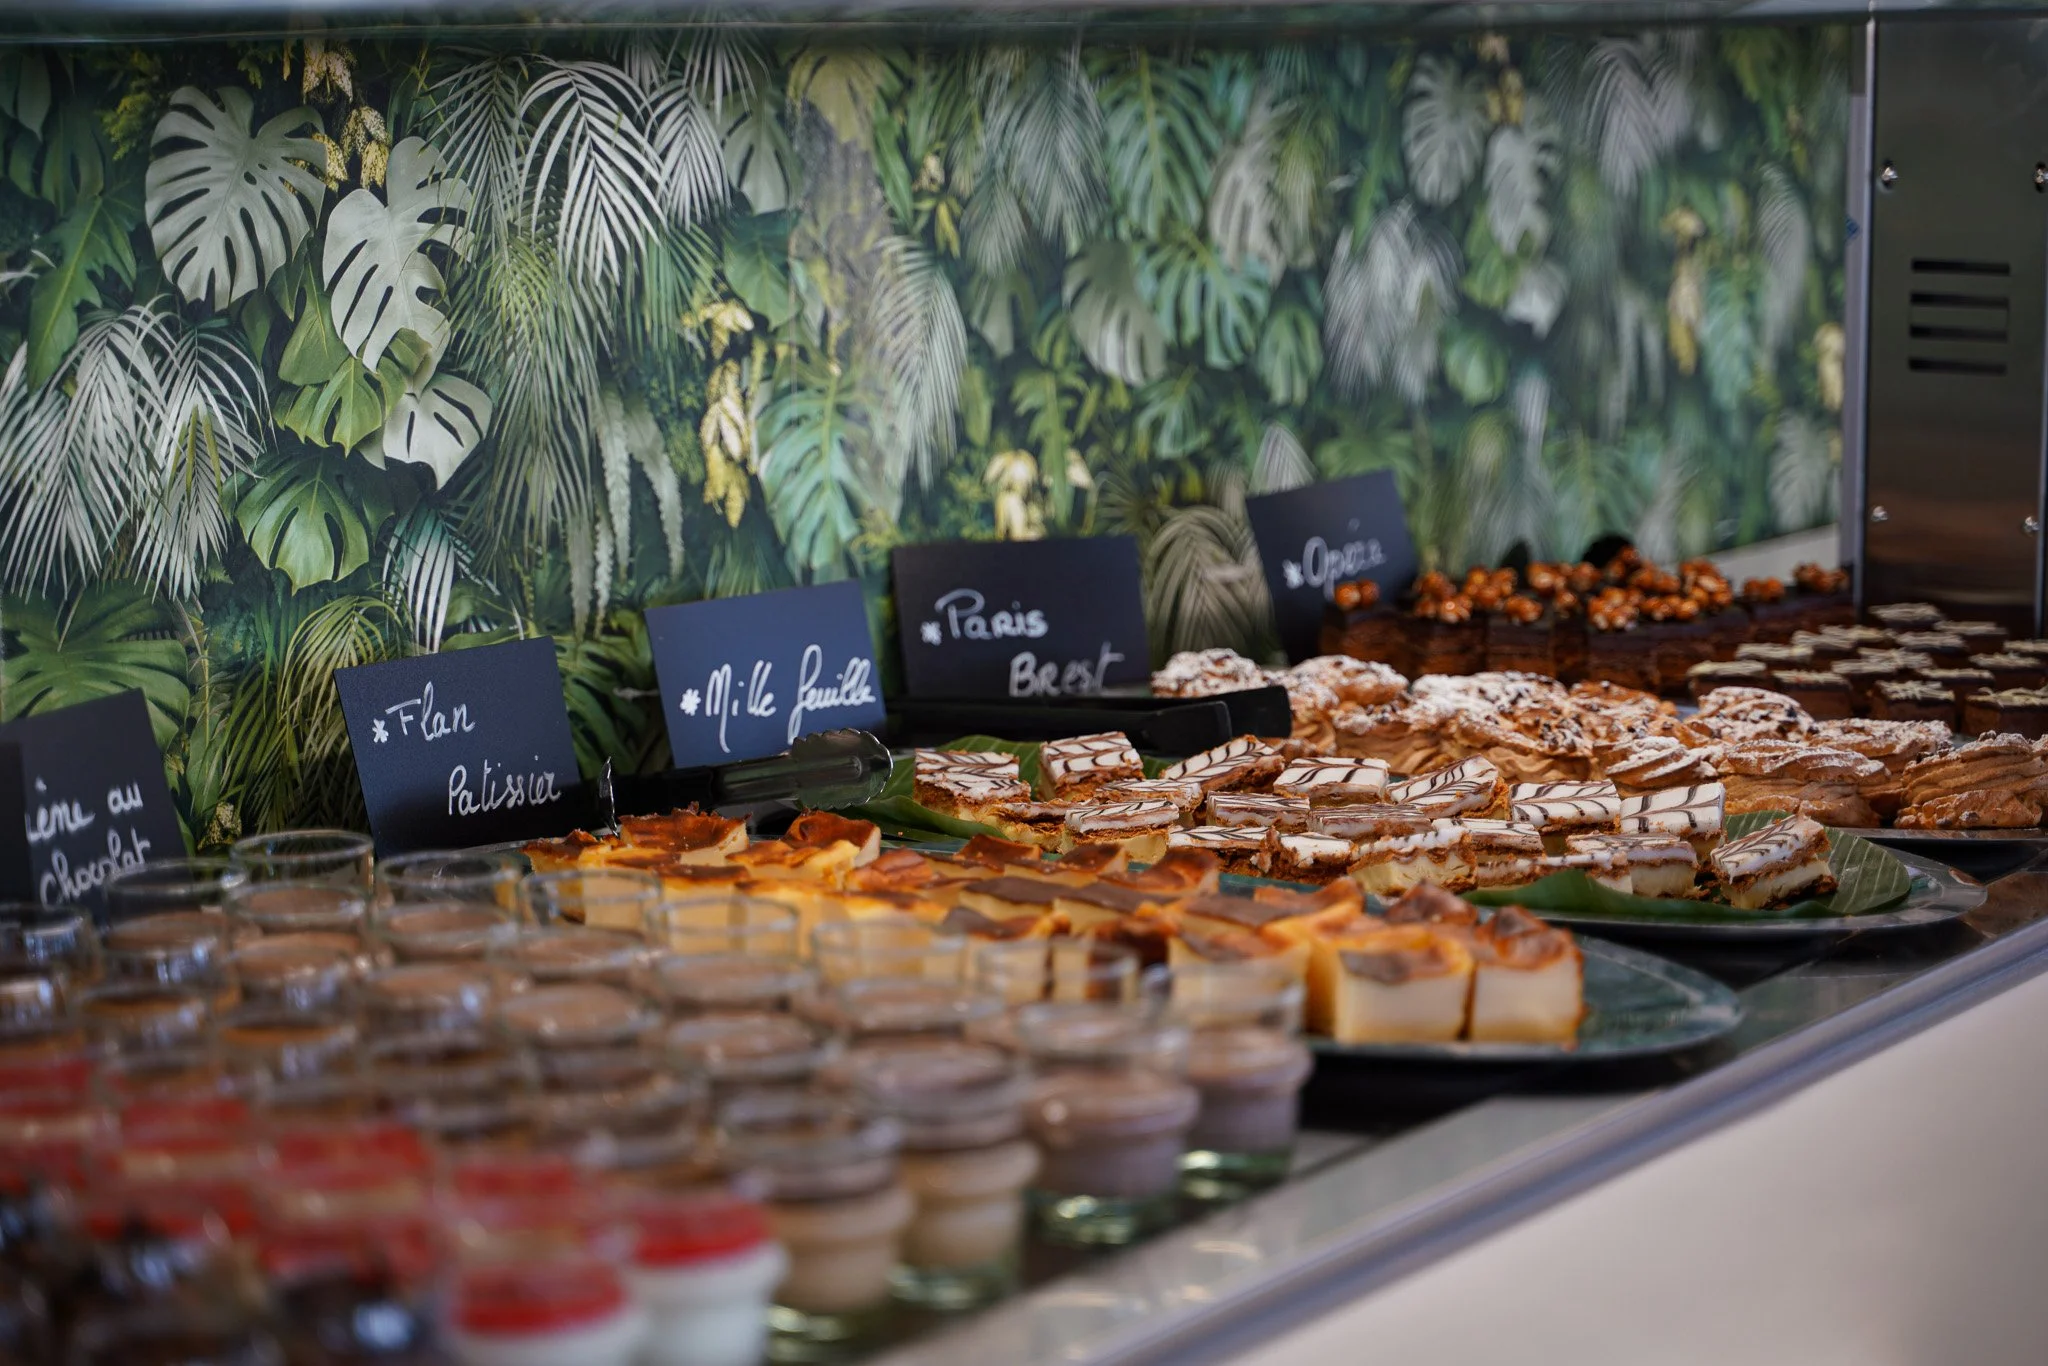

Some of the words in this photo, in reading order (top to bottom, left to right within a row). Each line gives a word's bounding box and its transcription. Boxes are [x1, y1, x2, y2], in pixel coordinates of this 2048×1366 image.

[935, 588, 1048, 639] Paris
[1009, 641, 1125, 697] Brest
[385, 681, 475, 741] Flan
[706, 660, 777, 753] Mille
[107, 782, 143, 815] au
[448, 755, 561, 816] Patissier
